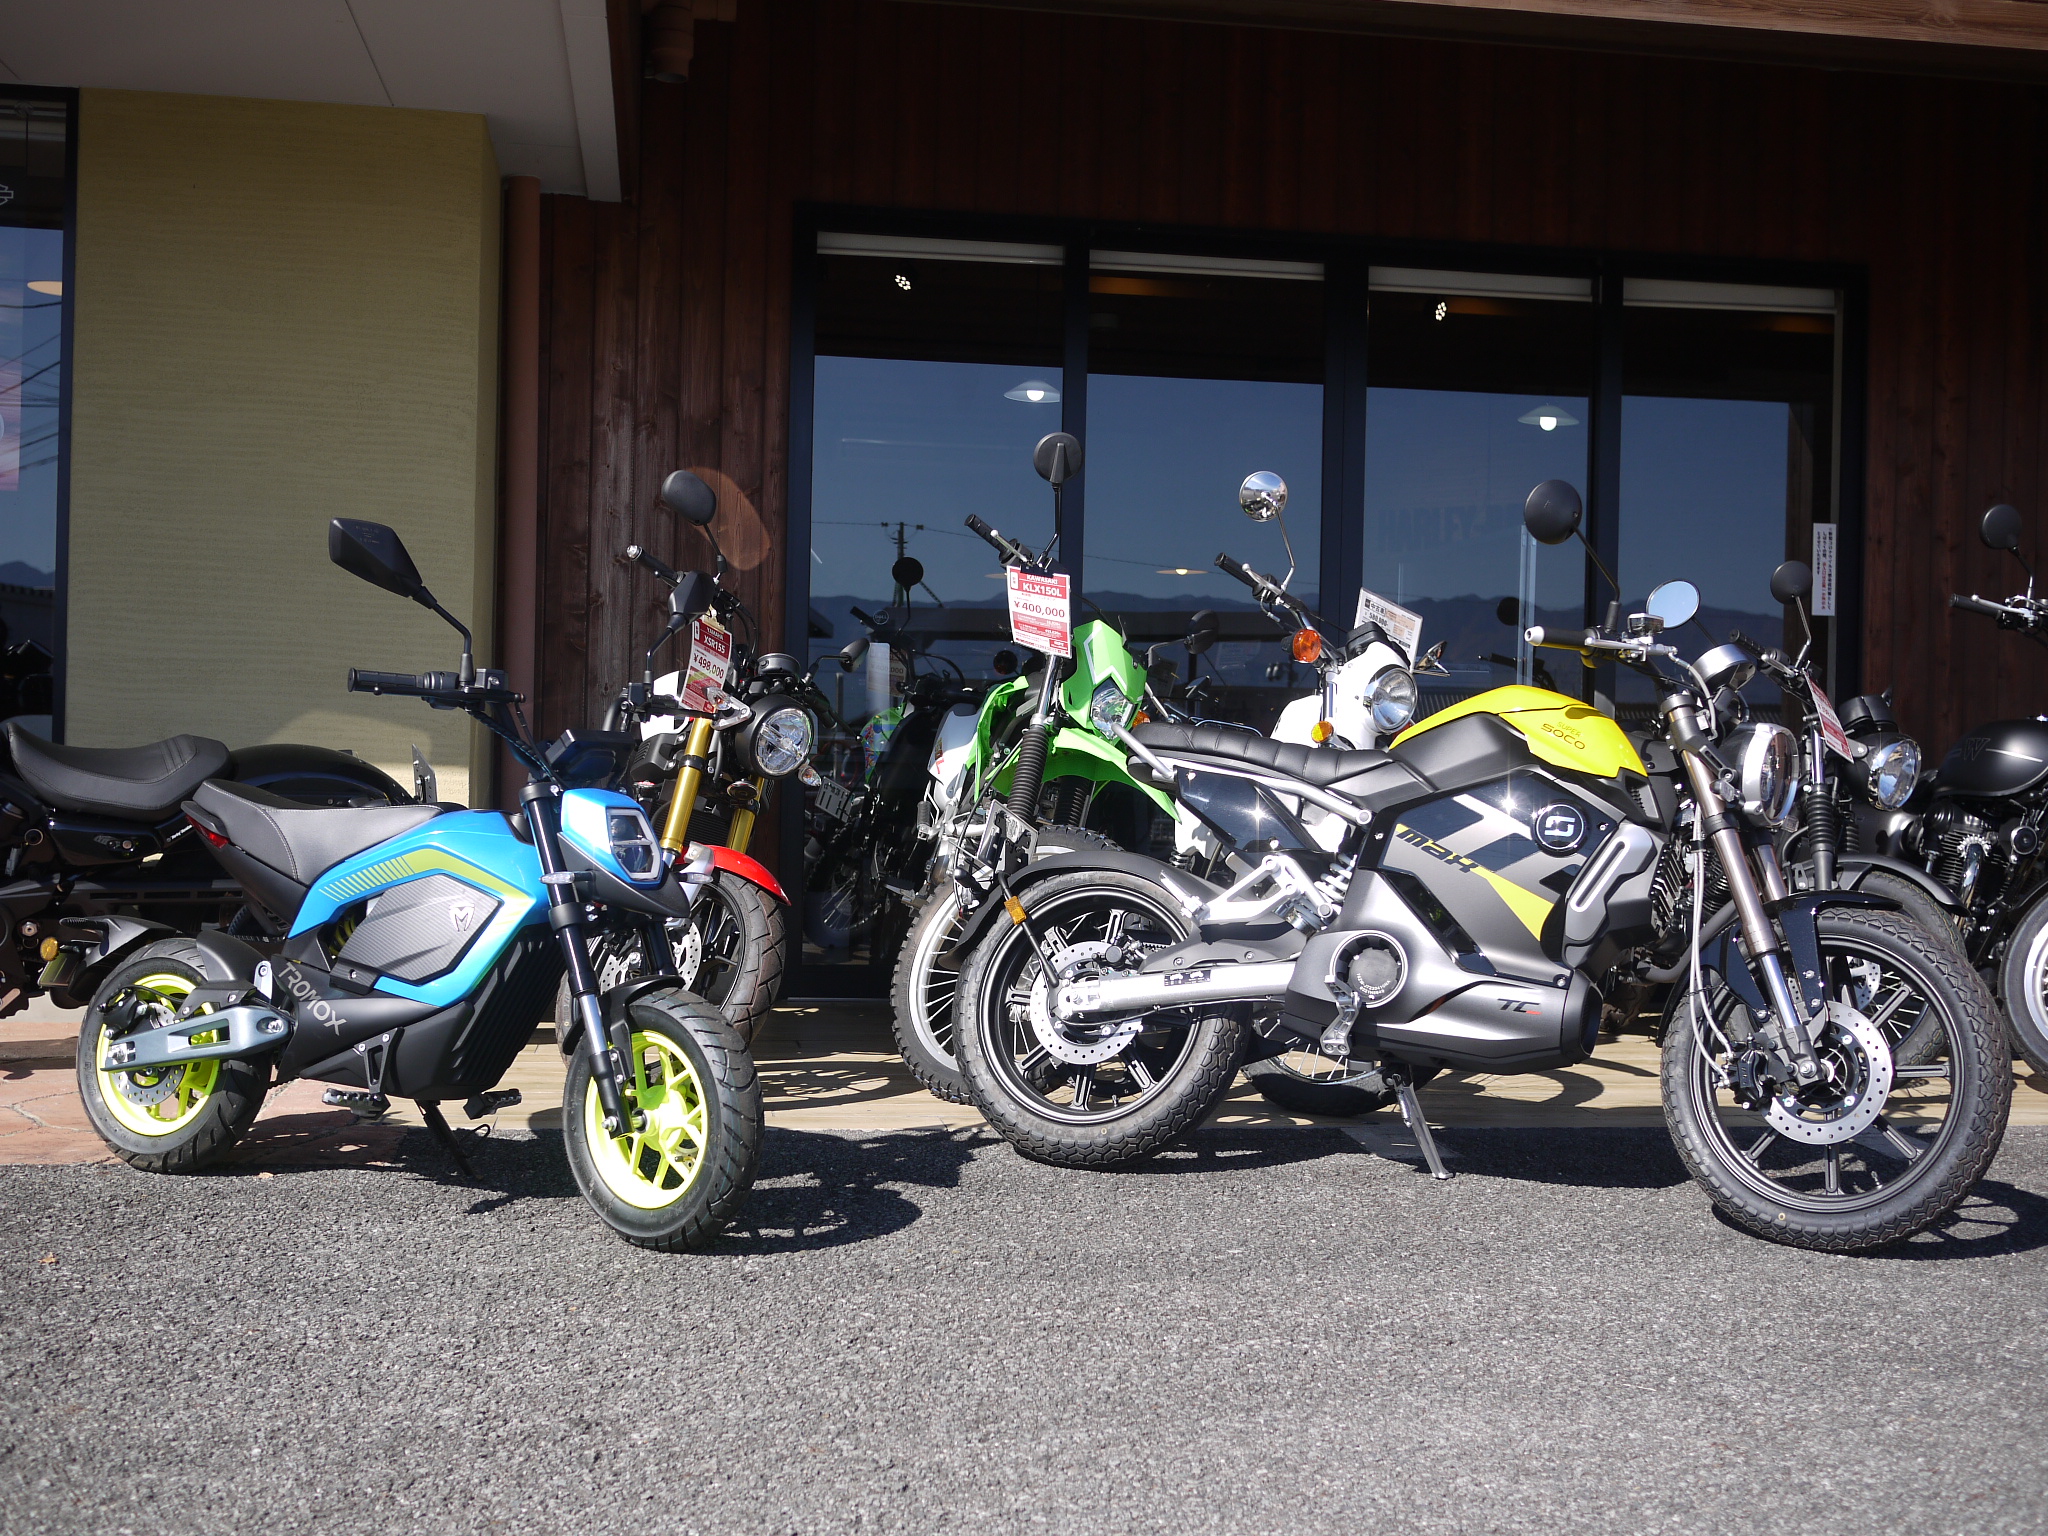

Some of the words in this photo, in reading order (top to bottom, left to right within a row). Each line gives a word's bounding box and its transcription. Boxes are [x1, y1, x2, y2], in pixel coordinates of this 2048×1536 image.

[1026, 574, 1059, 585] KAWASAKI
[1022, 582, 1063, 597] KLX150L
[706, 627, 724, 640] YAMAHA
[703, 635, 726, 654] XSR155
[693, 653, 725, 679] ¥498,000
[1541, 723, 1586, 750] SOCO
[1556, 721, 1582, 738] SUPER
[278, 961, 348, 1036] TROMOX
